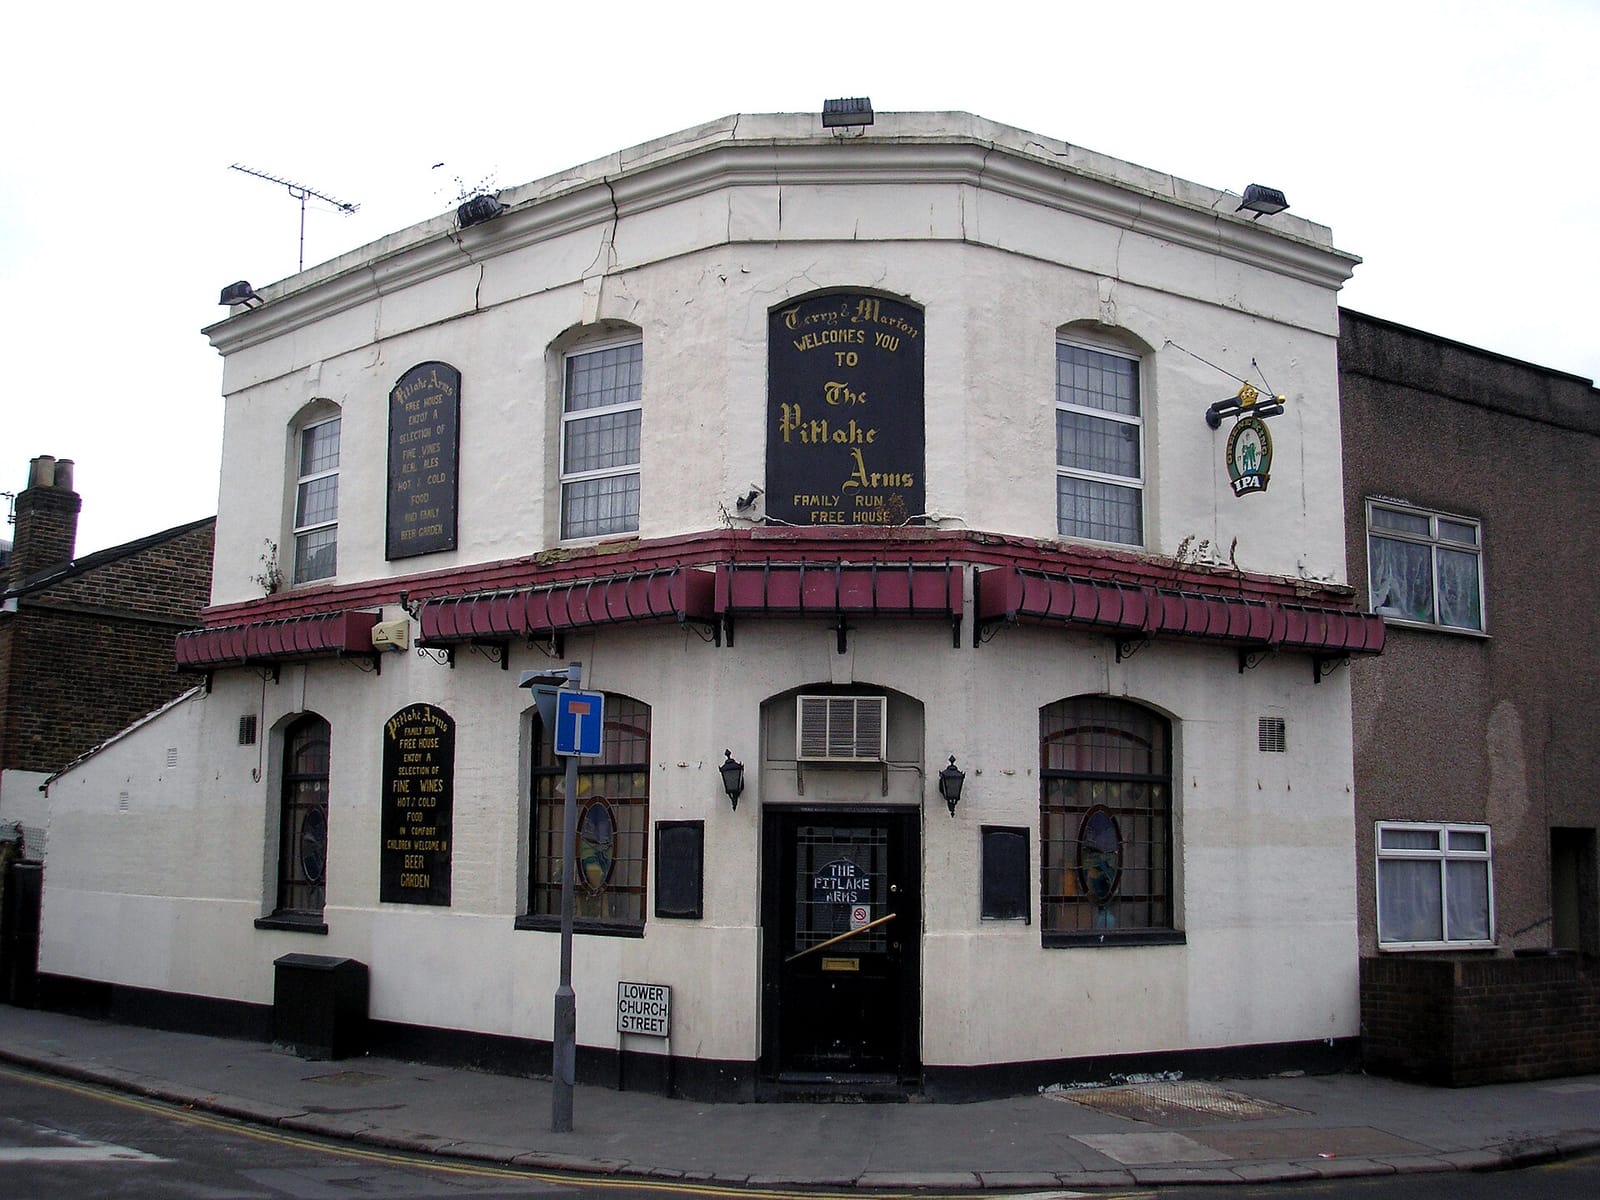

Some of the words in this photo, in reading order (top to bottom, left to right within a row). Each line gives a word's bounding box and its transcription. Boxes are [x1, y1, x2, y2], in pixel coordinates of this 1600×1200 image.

[781, 304, 838, 330] Terry
[850, 298, 919, 338] Marion
[793, 329, 865, 352] WELCOMES
[875, 331, 899, 351] YOU
[834, 351, 858, 367] TO
[427, 369, 453, 396] Arms
[824, 381, 867, 406] The
[432, 409, 439, 419] A
[779, 402, 879, 444] Pitlake
[399, 427, 432, 444] SELECTION
[436, 424, 446, 435] OF
[427, 472, 446, 485] COLD
[842, 448, 914, 495] Arms
[1234, 476, 1260, 492] IPA
[411, 493, 429, 505] FOOD
[793, 495, 840, 507] FAMILY
[855, 495, 883, 507] RUN
[810, 511, 845, 523] FREE
[853, 511, 890, 522] HOUSE
[418, 523, 443, 537] GARDEN
[422, 706, 448, 733] Arms
[399, 738, 417, 749] FREE
[418, 737, 440, 749] HOUSE
[403, 753, 422, 763] ENJOY
[425, 752, 432, 762] A
[398, 766, 430, 776] SELECTION
[431, 766, 440, 775] OF
[393, 779, 410, 793] FINE
[420, 779, 443, 793] WINES
[397, 797, 410, 808] HOT
[418, 797, 436, 808] COLD
[406, 811, 423, 822] FOOD
[411, 827, 436, 836] COMFORT
[387, 839, 411, 850] CHILDREN
[413, 840, 440, 851] WELCOME
[404, 854, 424, 869] BEER
[829, 865, 855, 877] THE
[400, 873, 430, 888] GARDEN
[814, 878, 870, 890] PITLAKE
[826, 891, 858, 902] ARMS
[624, 985, 664, 1001] LOWER
[619, 1000, 667, 1017] CHURCH
[621, 1015, 665, 1032] STREET
